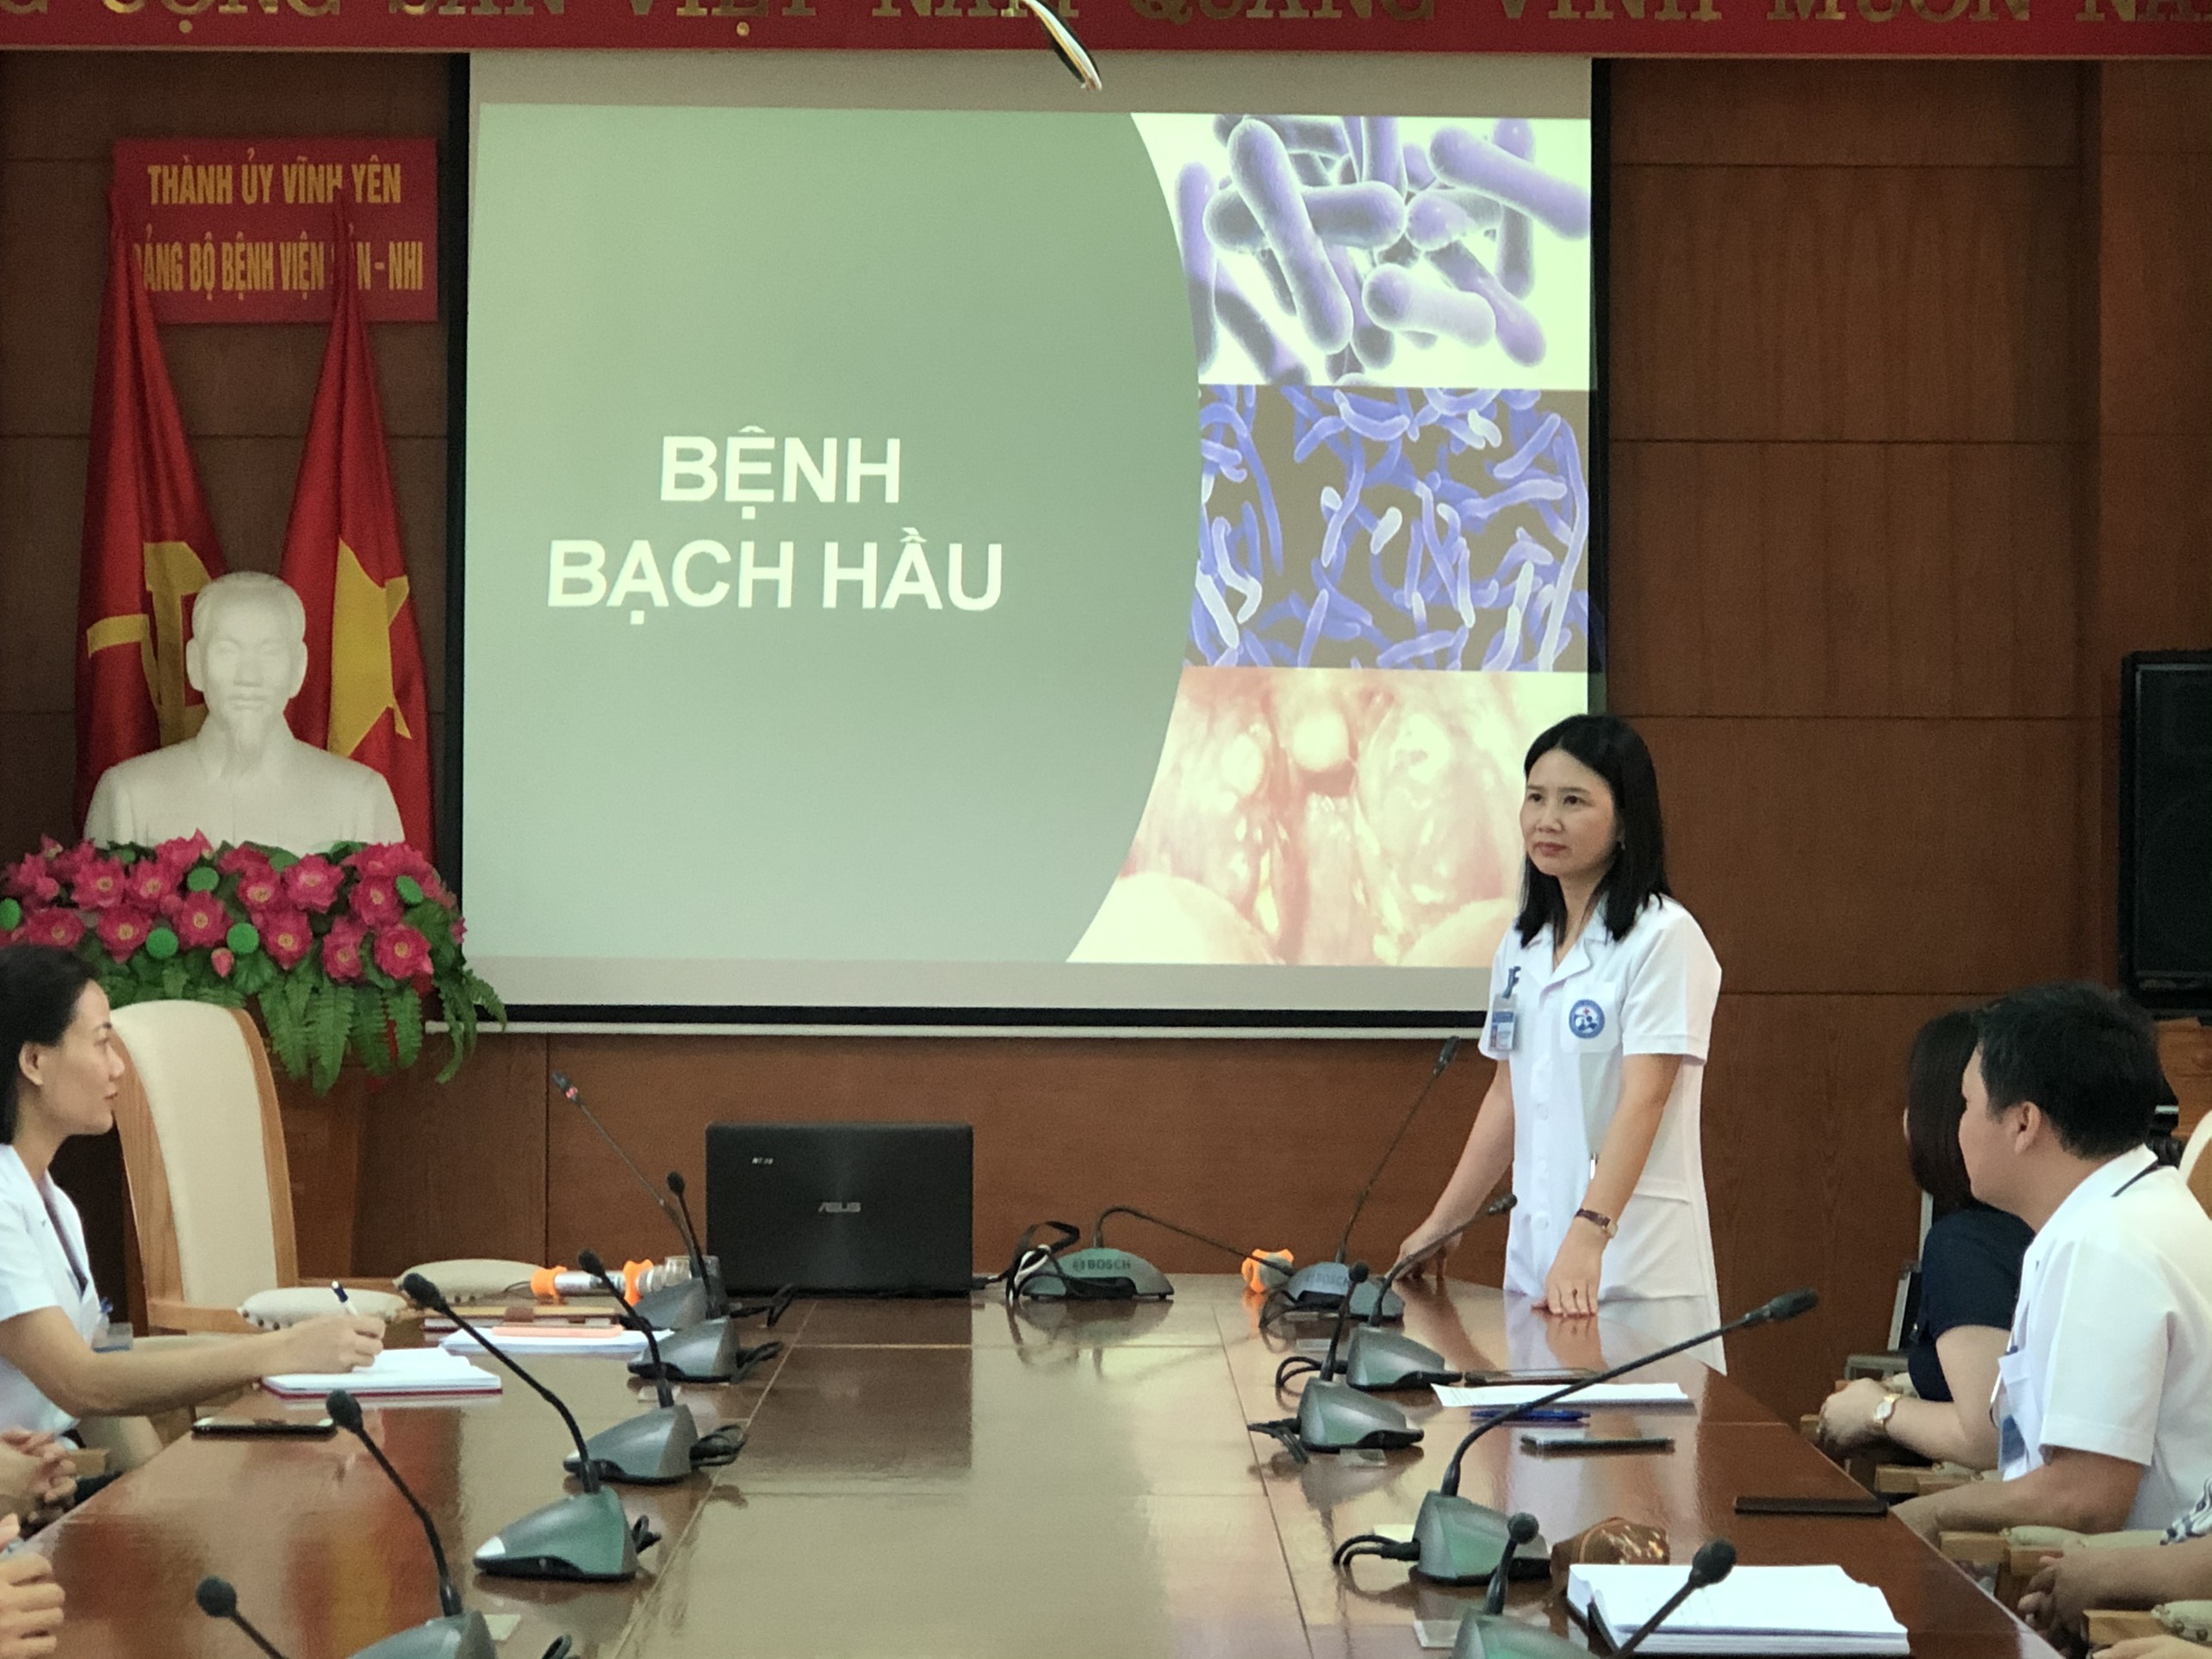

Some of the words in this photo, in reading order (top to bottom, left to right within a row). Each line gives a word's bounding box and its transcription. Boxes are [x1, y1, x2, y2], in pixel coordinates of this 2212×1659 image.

[147, 154, 233, 204] THÀNH
[241, 147, 274, 204] ỦY
[351, 154, 401, 203] YÊN
[190, 231, 215, 301] BỘ
[221, 231, 274, 301] BỆNH
[280, 230, 324, 300] VIỆN
[661, 426, 900, 519] BỆNH
[548, 539, 794, 624] BẠCH
[823, 527, 1002, 611] HẦU
[817, 1202, 861, 1213] ASUS
[1088, 1258, 1131, 1271] BOSCH
